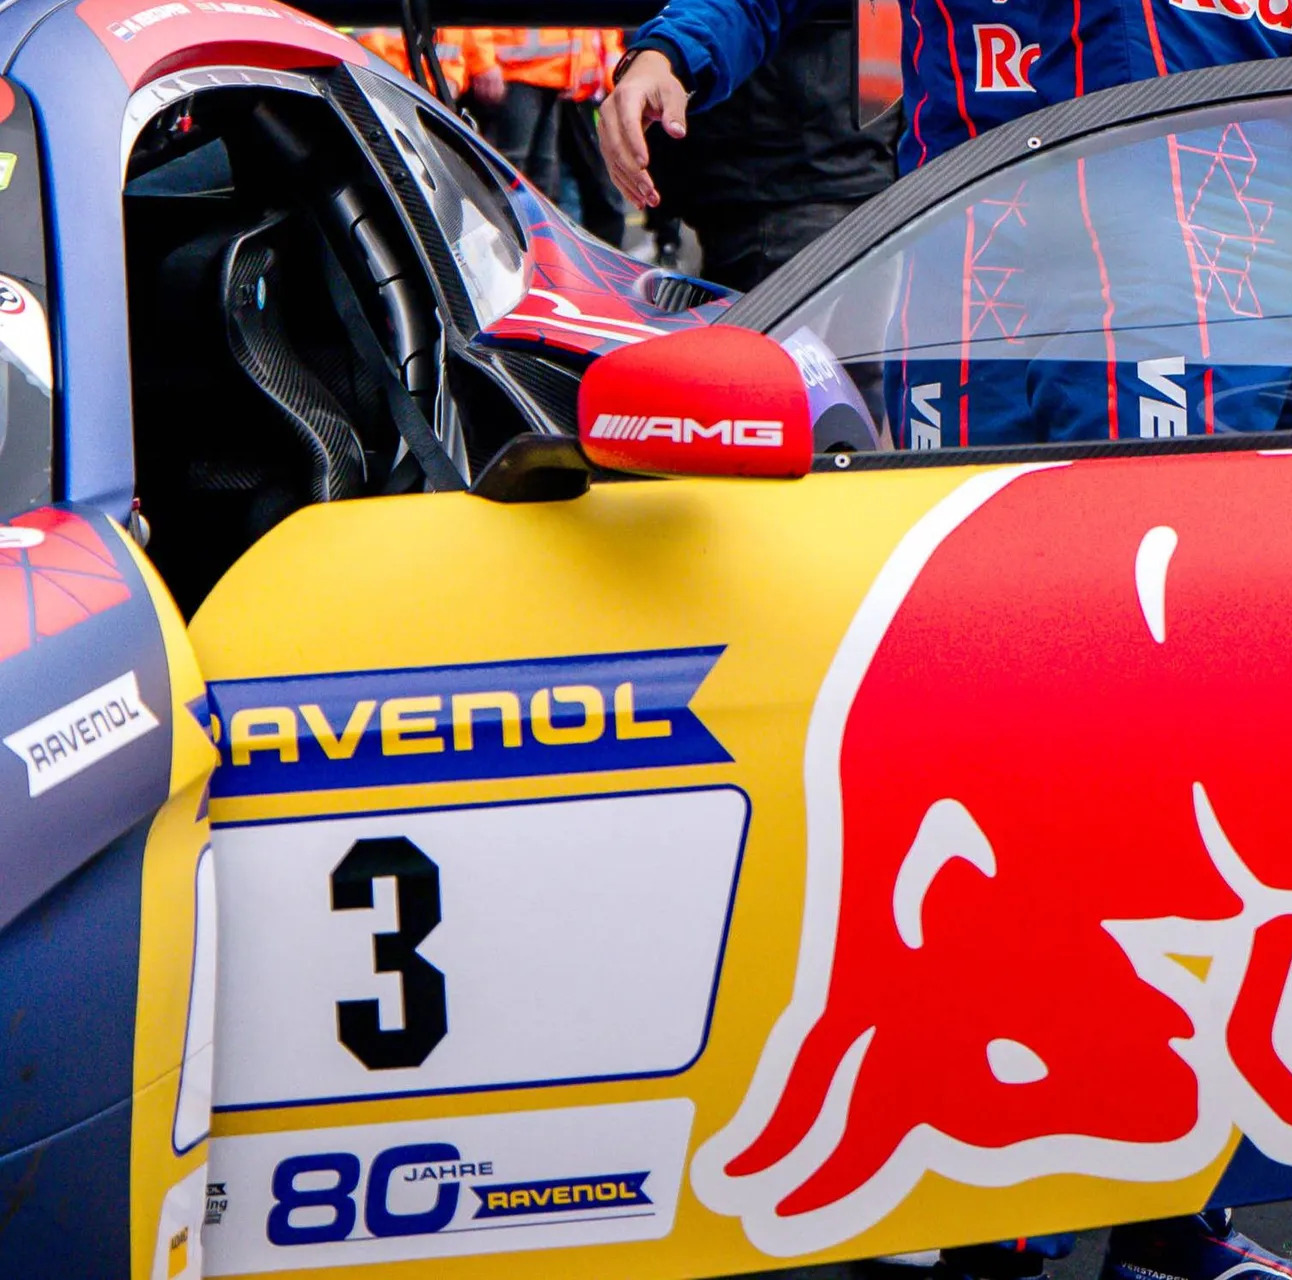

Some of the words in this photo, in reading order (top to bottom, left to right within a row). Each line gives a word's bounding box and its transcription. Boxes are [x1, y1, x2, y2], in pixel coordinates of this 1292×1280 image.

[638, 416, 784, 447] AMG
[28, 696, 140, 772] RAVENOL
[330, 835, 449, 1071] 3
[266, 1142, 461, 1246] 80
[403, 1160, 494, 1182] JAHRE
[487, 1181, 637, 1211] RAVENOL
